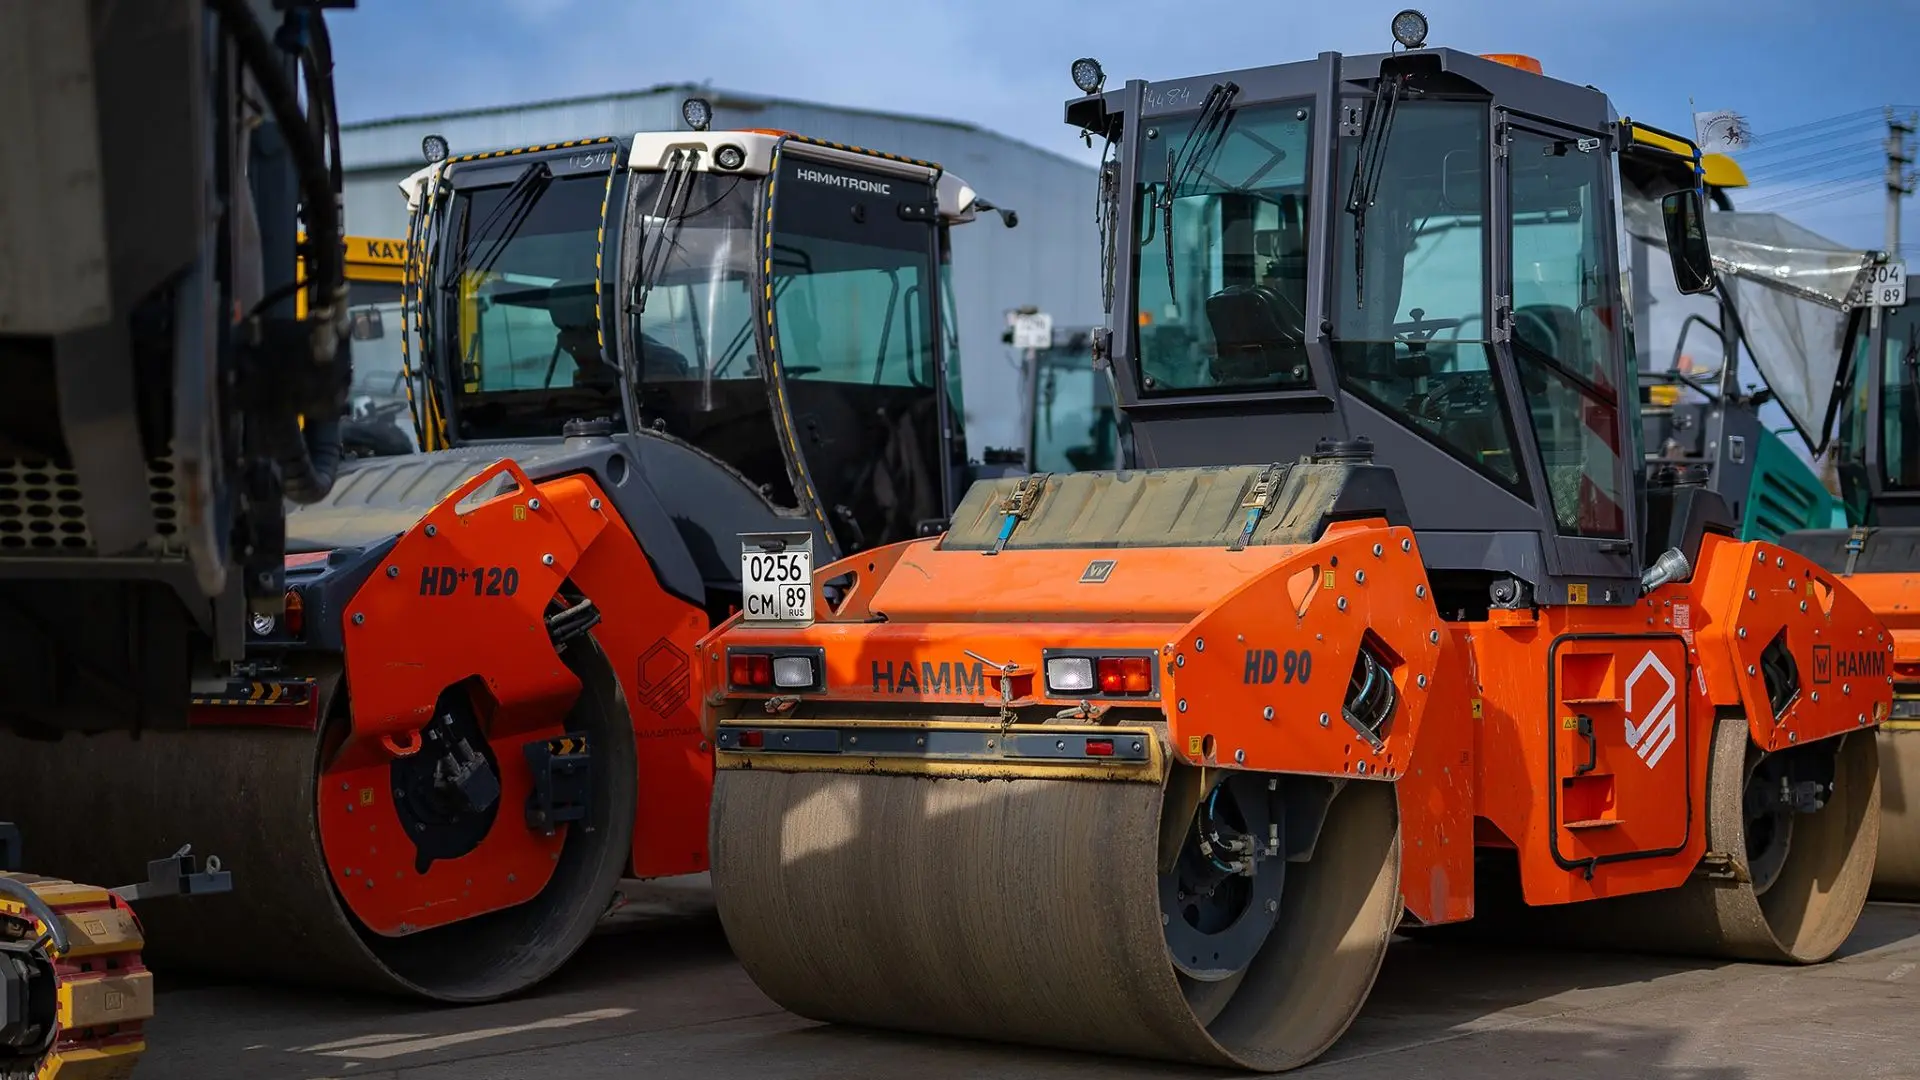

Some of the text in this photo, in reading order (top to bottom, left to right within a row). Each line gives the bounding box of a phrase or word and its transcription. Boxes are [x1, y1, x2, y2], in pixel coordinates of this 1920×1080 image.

[797, 168, 891, 195] HAMMTRONIC
[1884, 289, 1900, 302] 89
[751, 555, 802, 582] 0256
[748, 587, 806, 615] CM 89
[788, 608, 805, 617] RUS
[871, 660, 985, 695] HAMM
[1243, 649, 1312, 685] HD 90
[1836, 651, 1885, 677] HAMM
